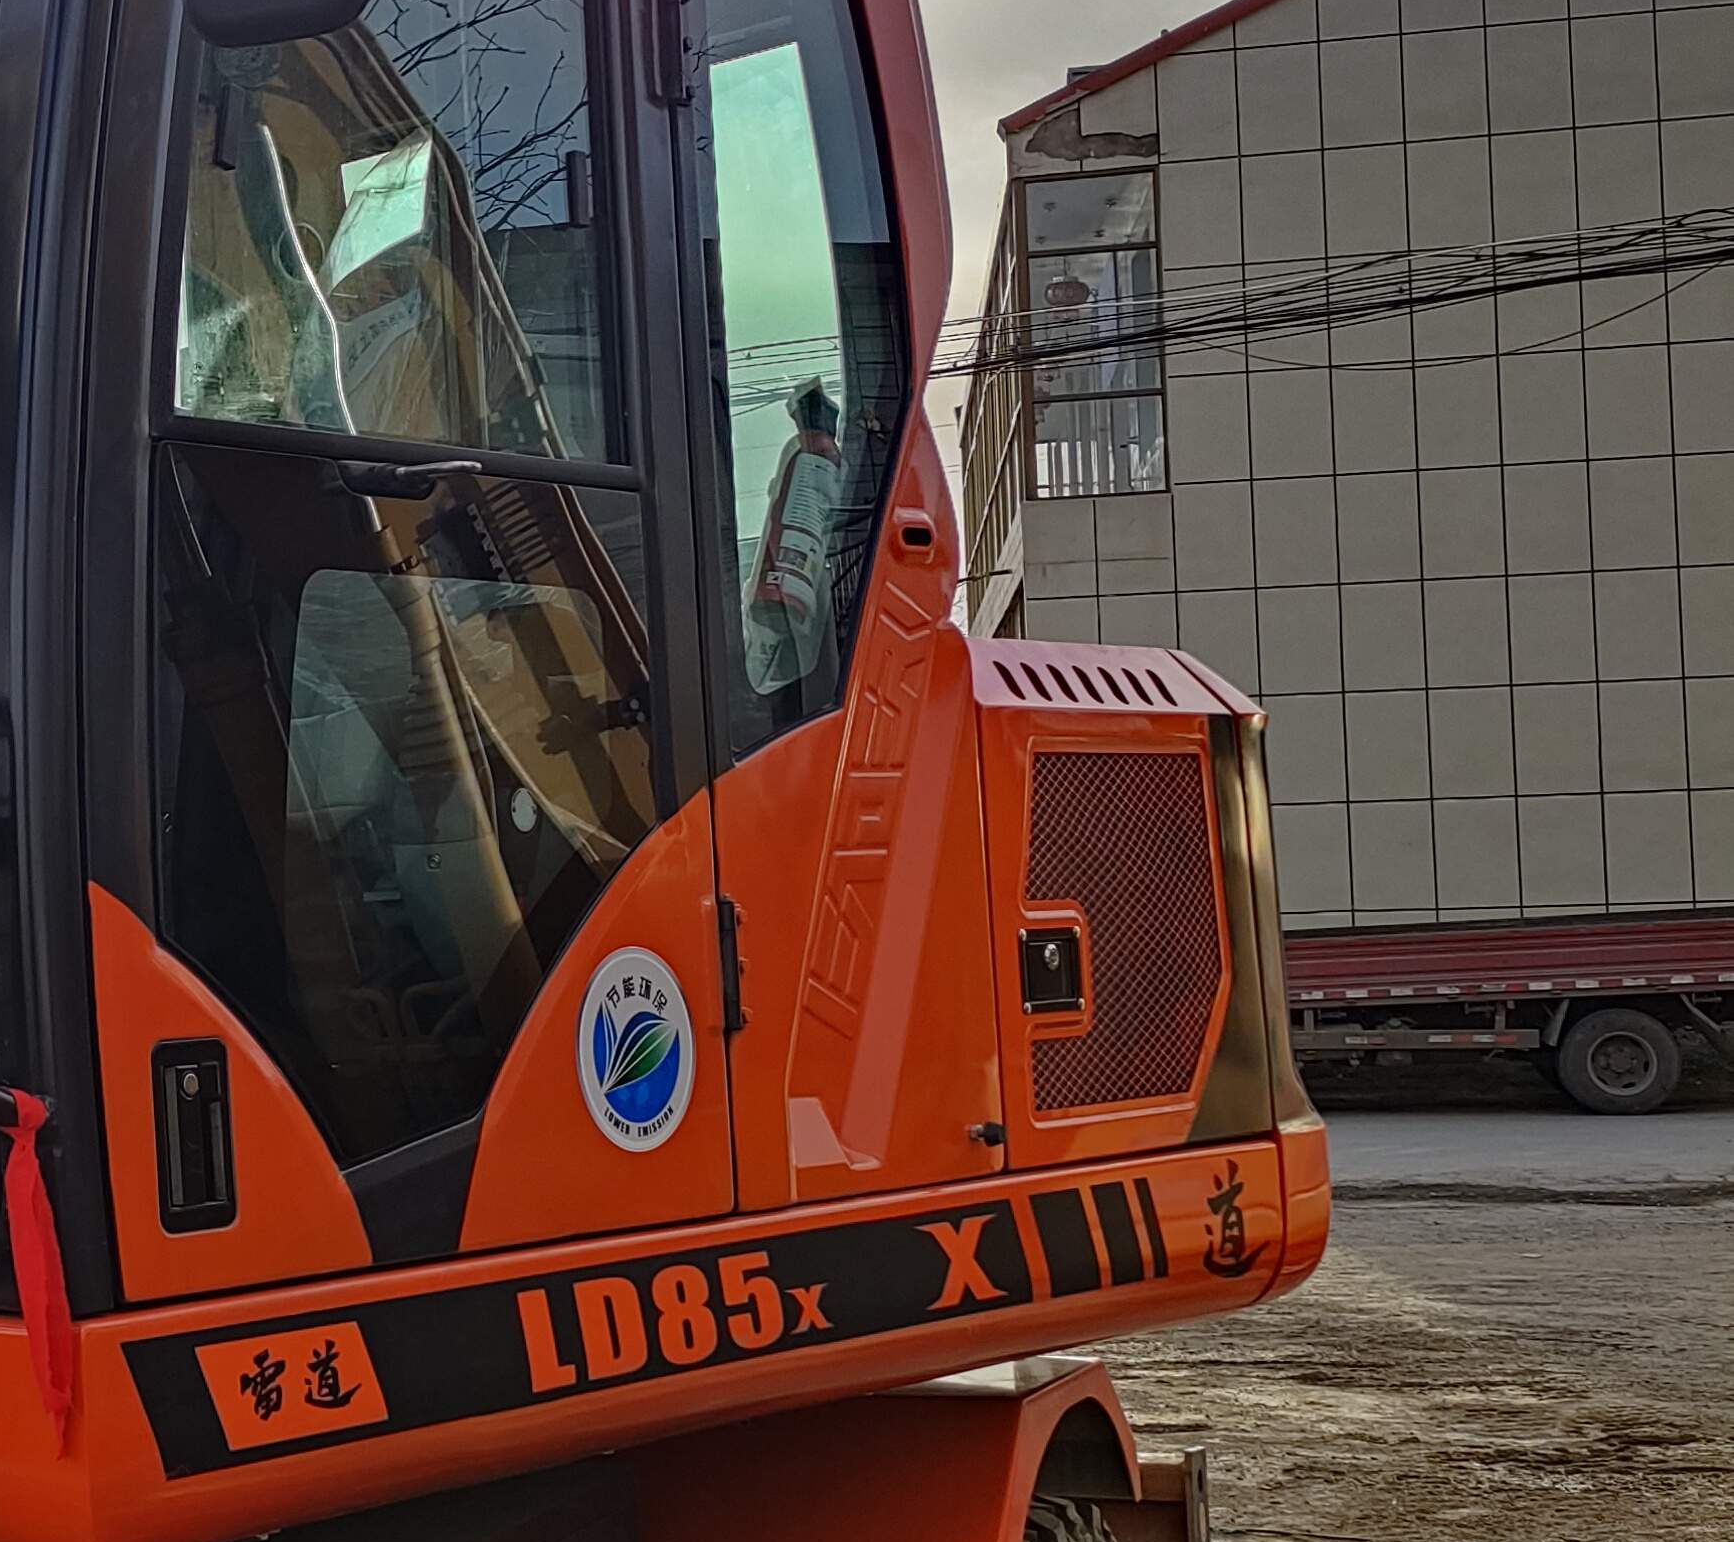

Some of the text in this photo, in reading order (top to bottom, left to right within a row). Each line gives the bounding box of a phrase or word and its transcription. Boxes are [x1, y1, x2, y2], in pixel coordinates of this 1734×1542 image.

[605, 975, 668, 1015] 节能环保
[604, 1106, 675, 1138] LOWER EMISSION
